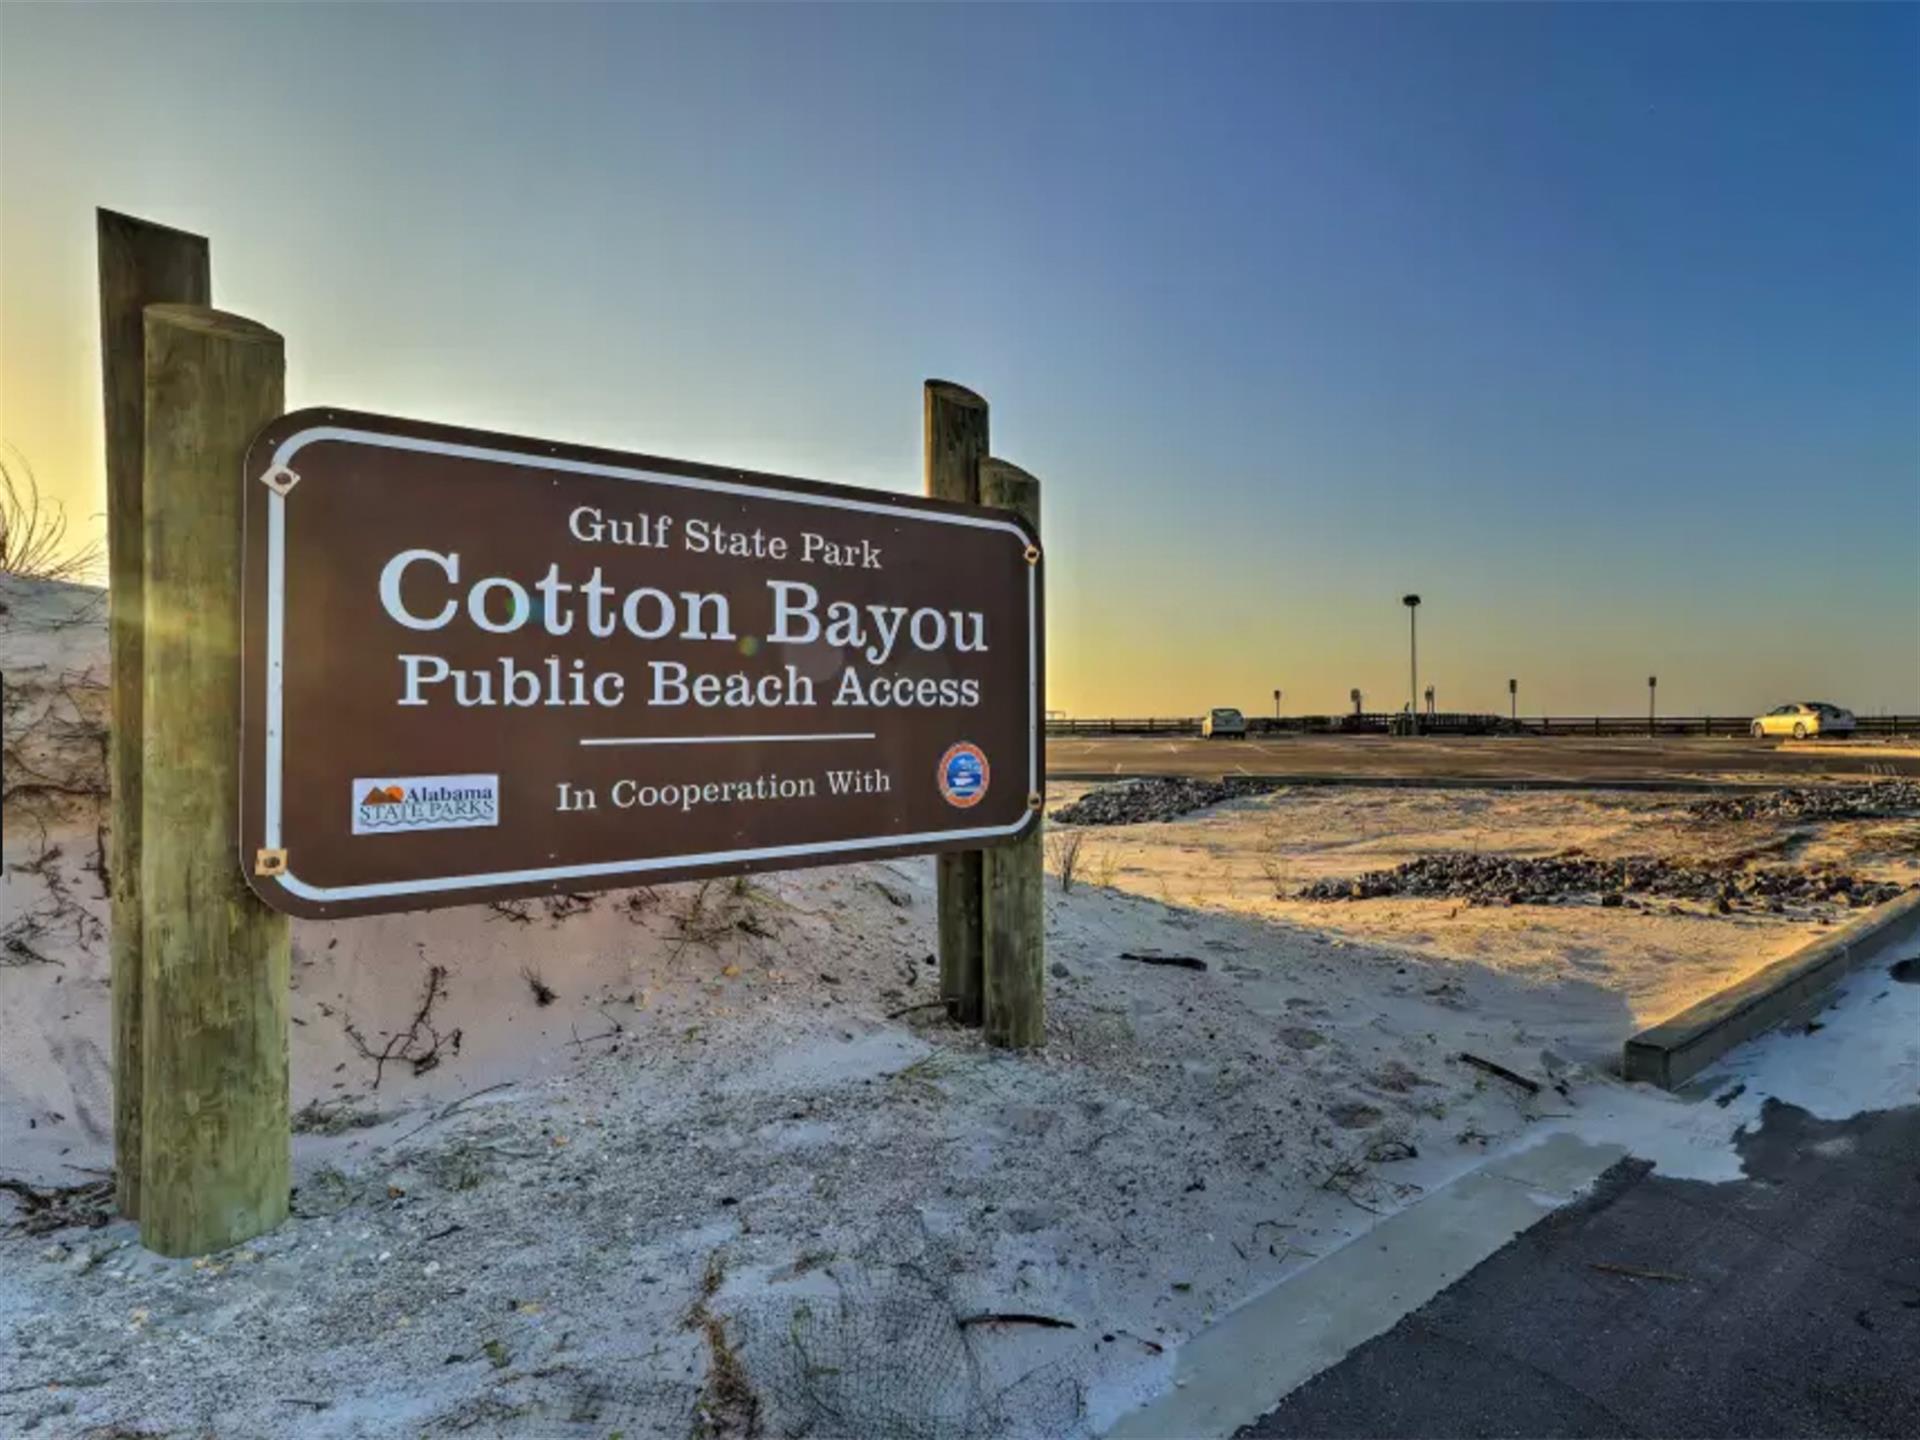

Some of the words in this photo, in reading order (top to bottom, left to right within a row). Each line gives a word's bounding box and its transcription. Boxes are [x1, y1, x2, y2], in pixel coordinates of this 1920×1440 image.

[568, 506, 673, 548] Gulf
[685, 518, 788, 560] State
[800, 533, 883, 569] Park
[379, 548, 737, 639] Cotton
[766, 580, 989, 665] Bayou
[397, 654, 625, 707] Public
[648, 660, 817, 707] Beach
[832, 666, 980, 707] Access
[360, 802, 423, 820] STATE
[430, 800, 494, 817] PARKS
[405, 786, 493, 803] Alabama
[556, 782, 598, 811] In
[611, 773, 816, 811] Cooperation
[826, 769, 892, 794] With
